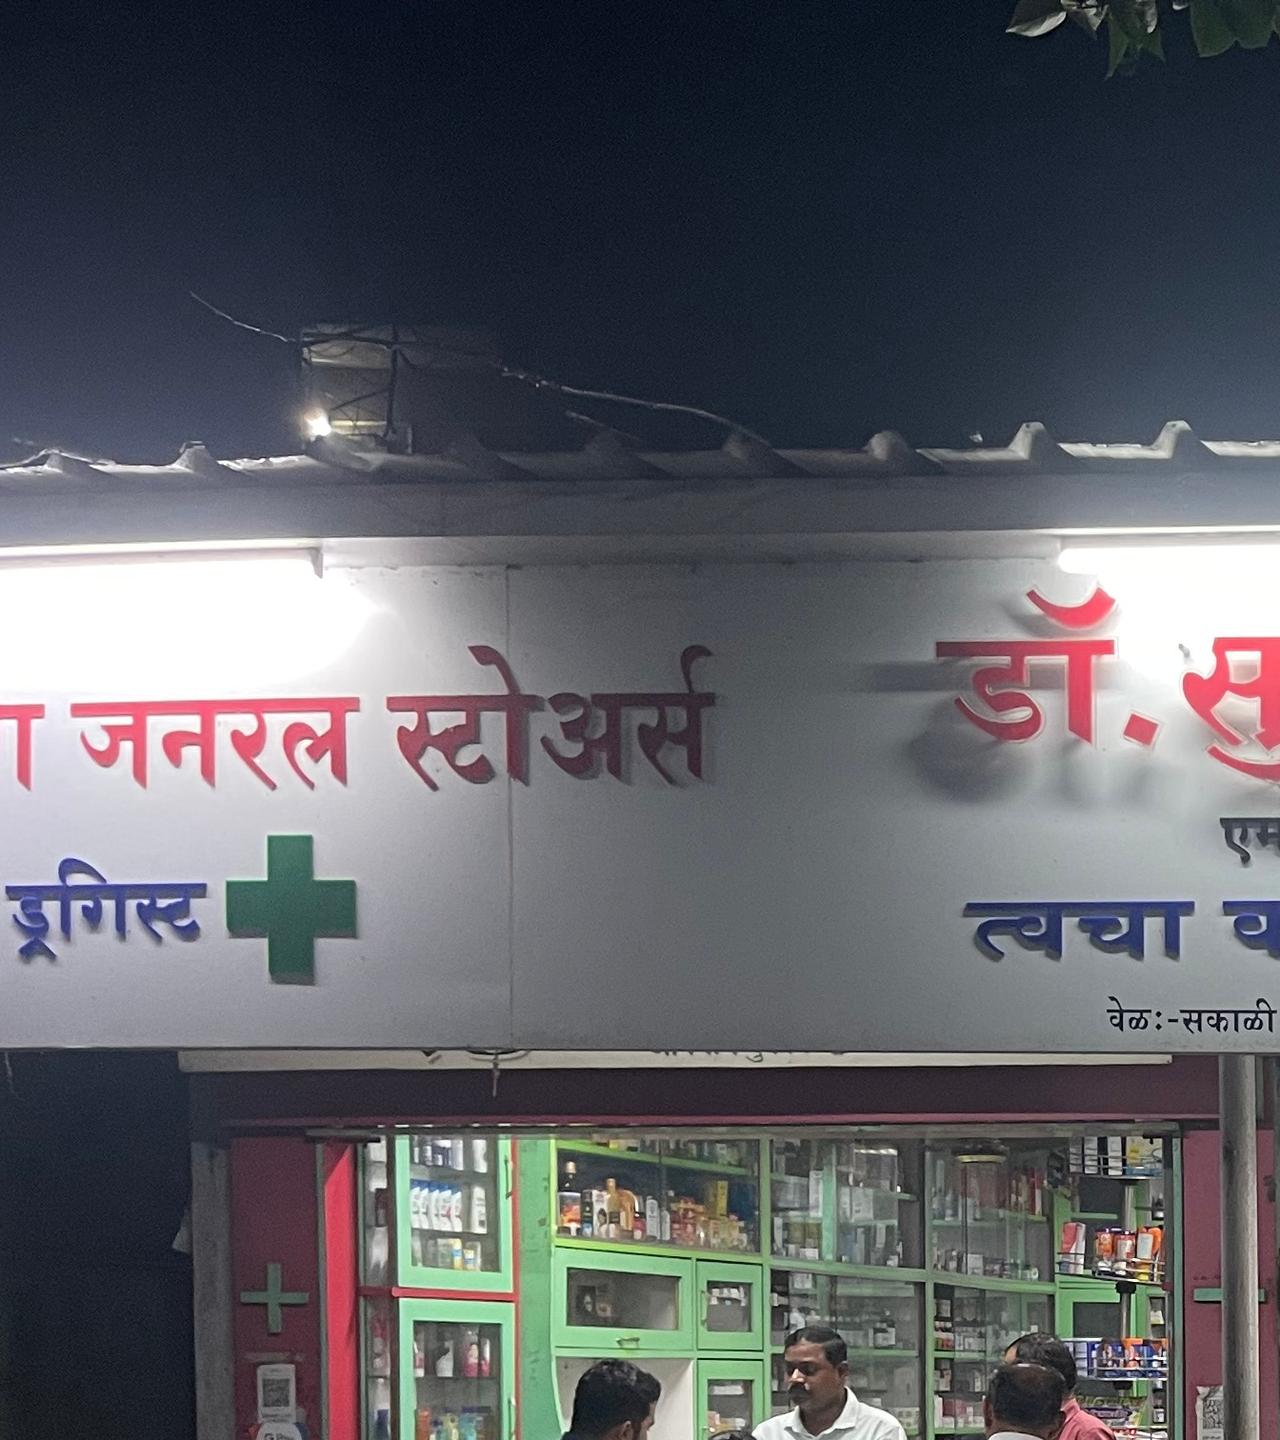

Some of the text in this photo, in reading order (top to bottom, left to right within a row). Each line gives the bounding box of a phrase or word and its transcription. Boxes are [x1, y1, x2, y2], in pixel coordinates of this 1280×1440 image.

[70, 696, 361, 791] जनरल
[386, 644, 716, 792] स्टोअर्स
[936, 585, 1160, 746] डॉ.
[964, 900, 1195, 962] त्वचा
